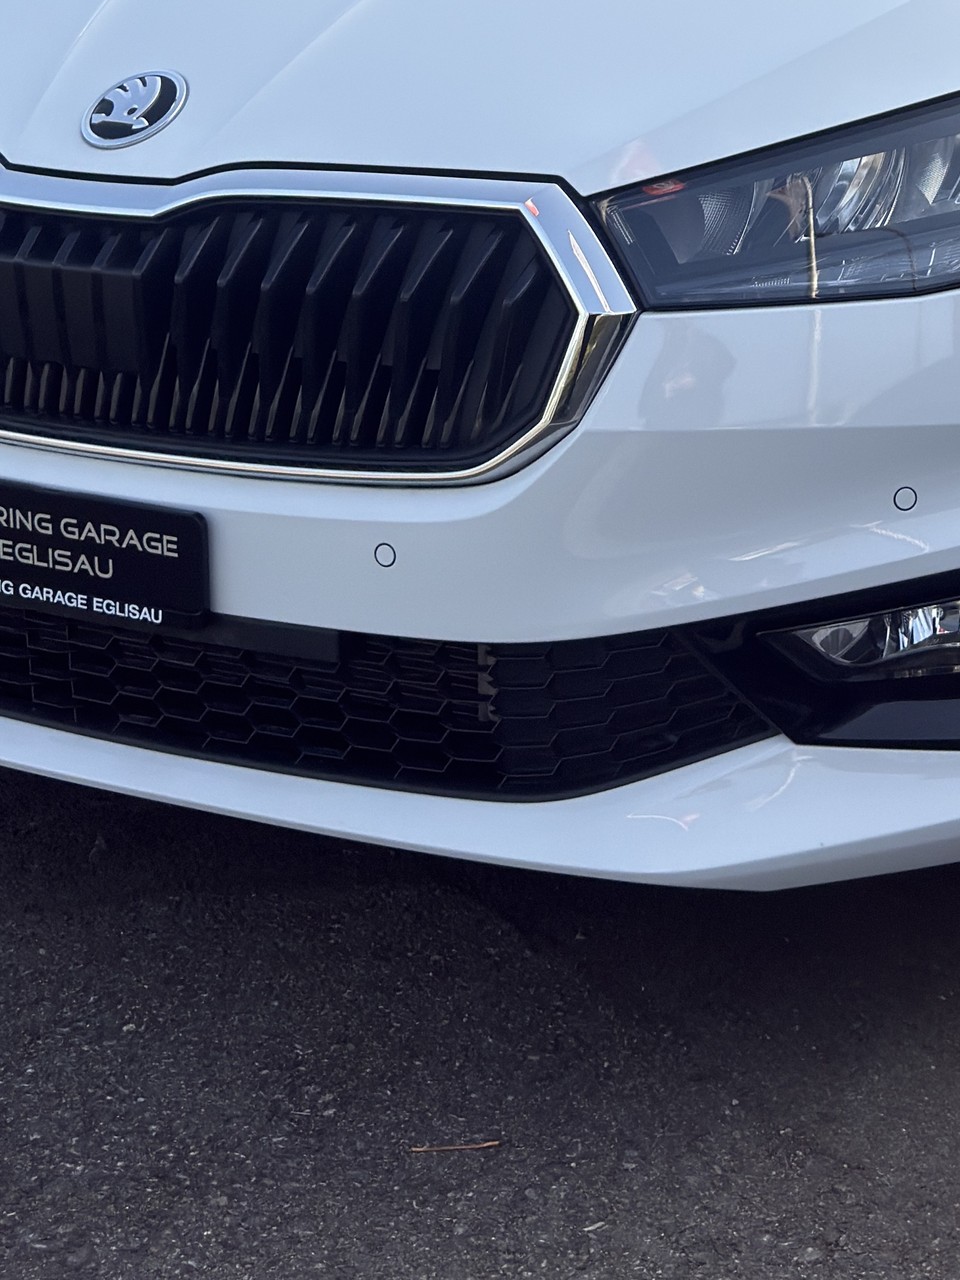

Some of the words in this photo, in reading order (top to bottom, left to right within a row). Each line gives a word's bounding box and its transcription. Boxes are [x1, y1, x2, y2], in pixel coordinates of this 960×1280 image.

[60, 517, 178, 557] GARAGE
[0, 539, 113, 579] EGLISAU
[0, 579, 14, 595] G
[19, 583, 88, 610] GARAGE
[93, 597, 163, 624] EGLISAU
